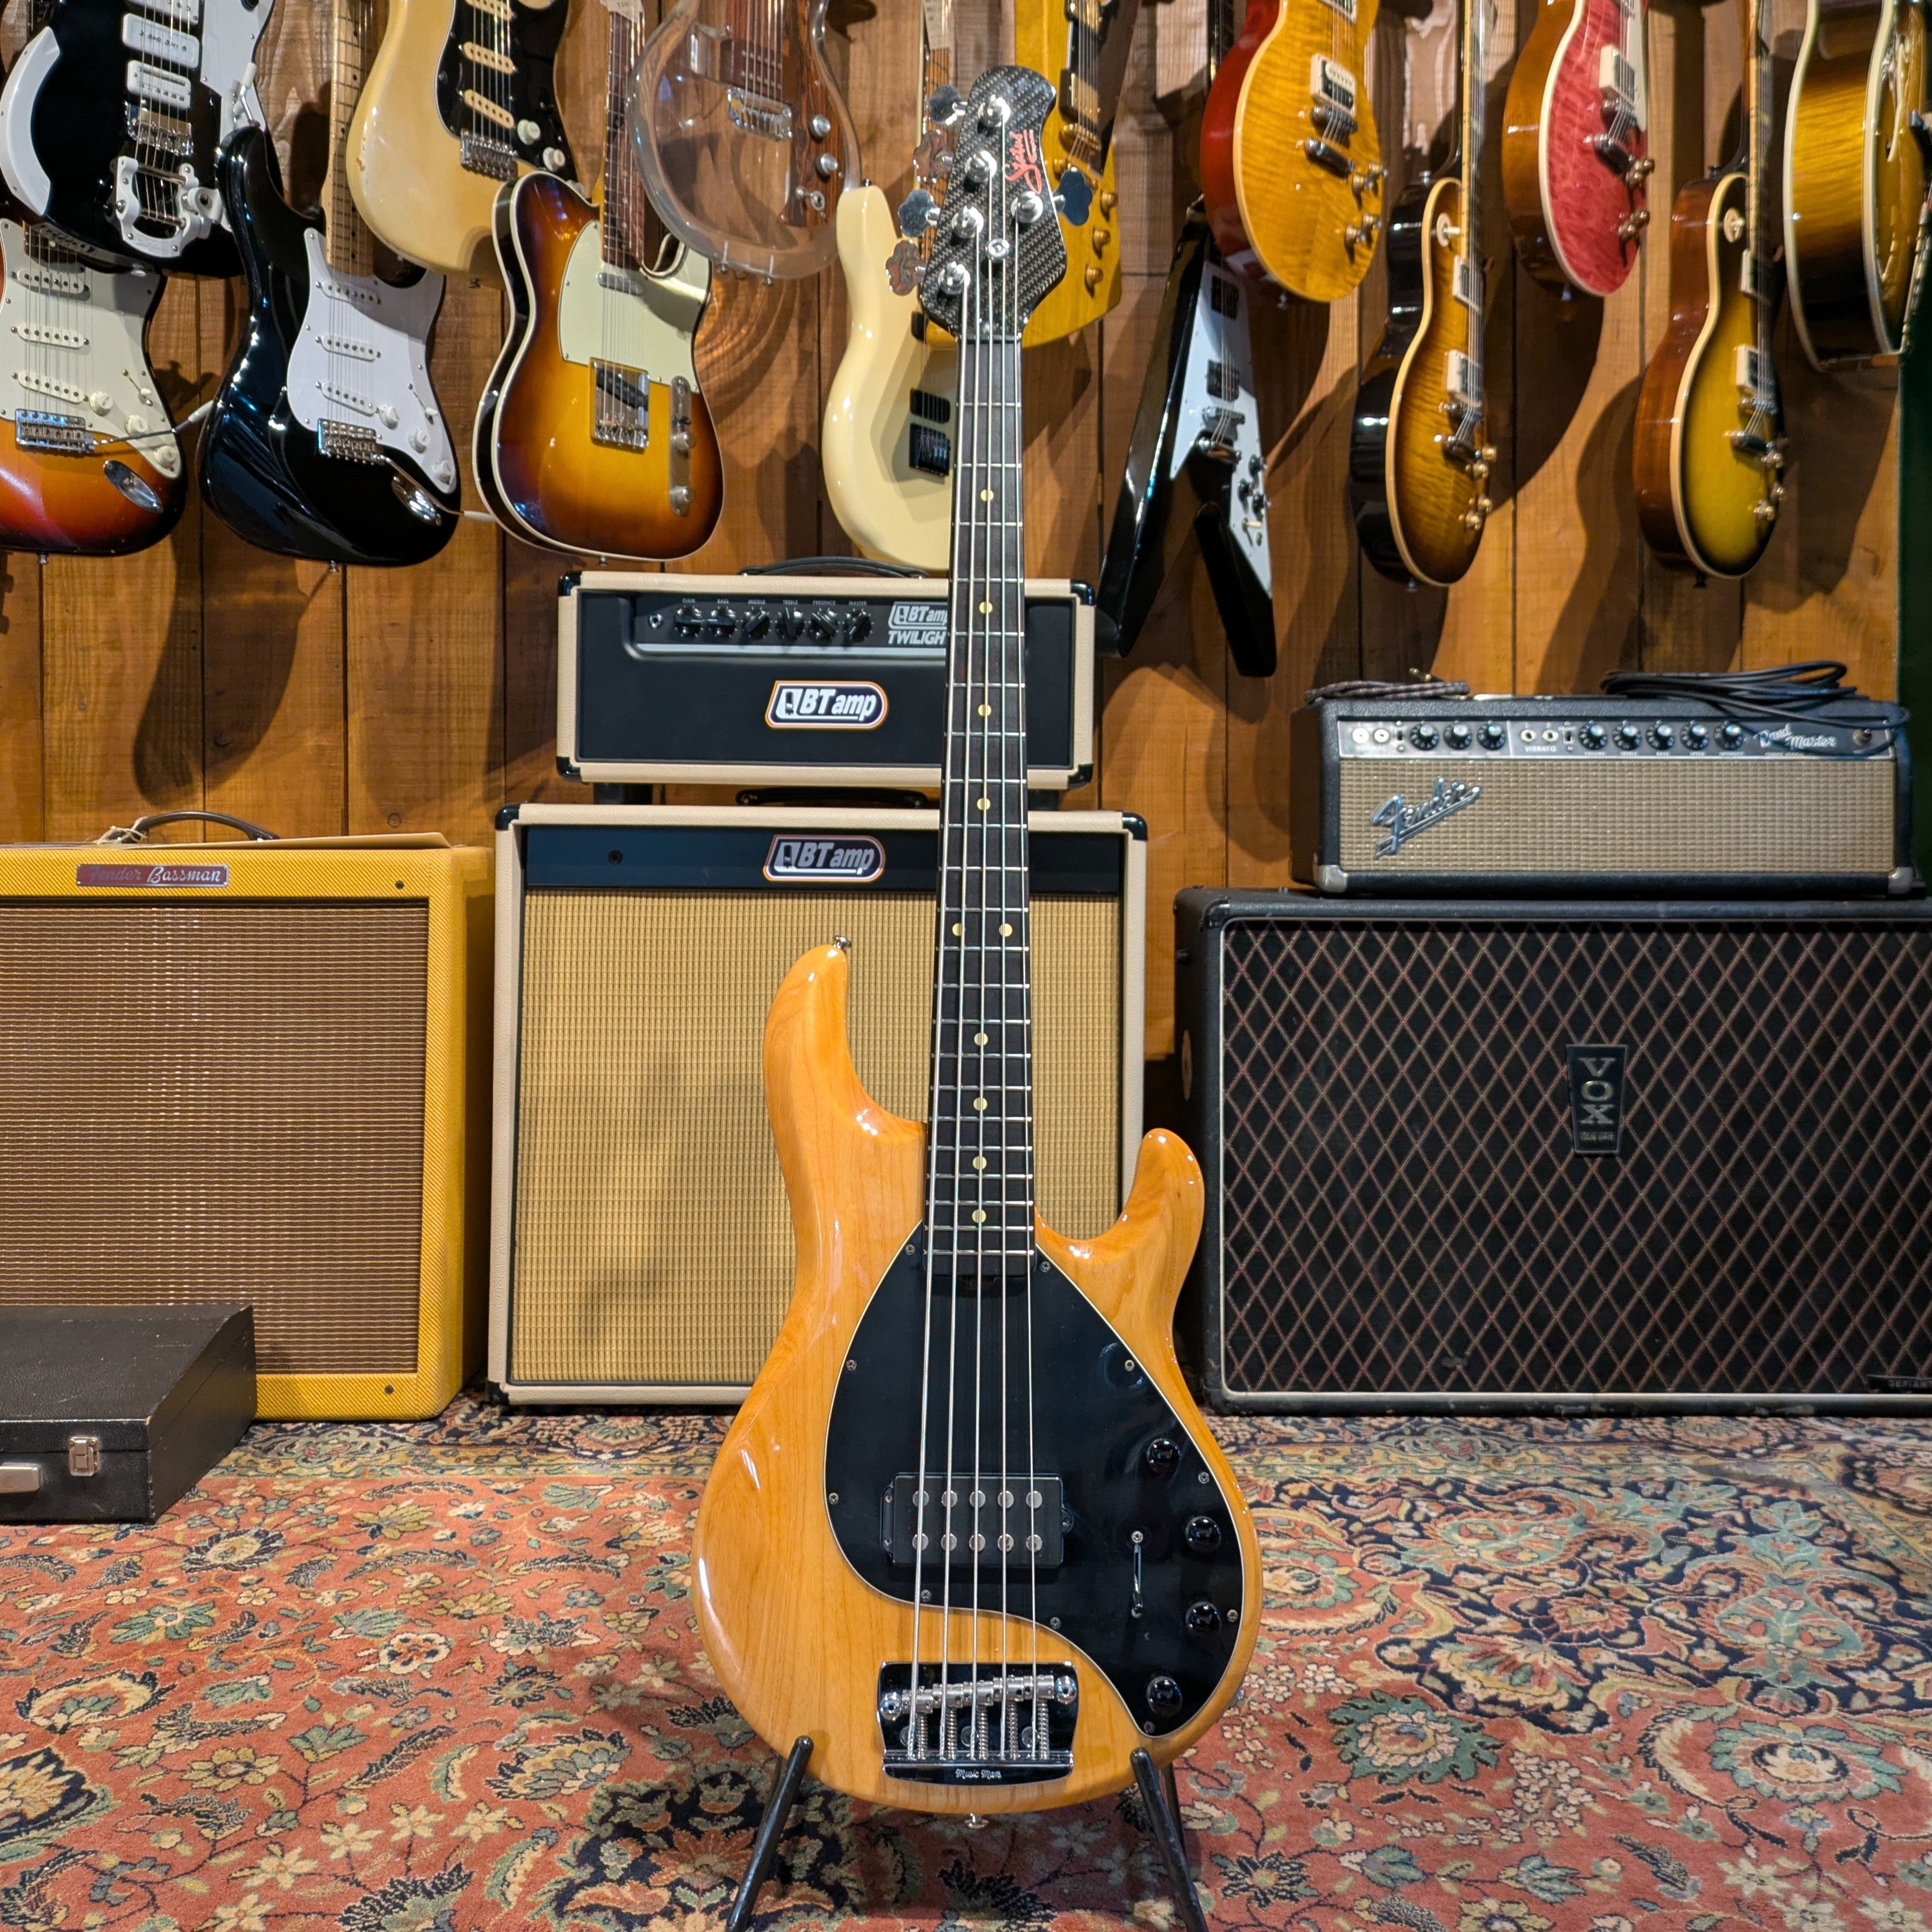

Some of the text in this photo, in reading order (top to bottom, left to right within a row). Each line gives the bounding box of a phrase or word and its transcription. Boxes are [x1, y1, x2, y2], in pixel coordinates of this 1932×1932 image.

[907, 605, 930, 623] BT
[888, 630, 947, 645] TWILIGH
[799, 688, 877, 722] BT amp
[1784, 733, 1837, 750] Master
[1370, 775, 1483, 861] Fender
[797, 842, 875, 875] BT amp
[88, 865, 221, 885] Fender Bassman
[1578, 1057, 1616, 1125] VOX
[955, 1768, 1002, 1780] Music Man
